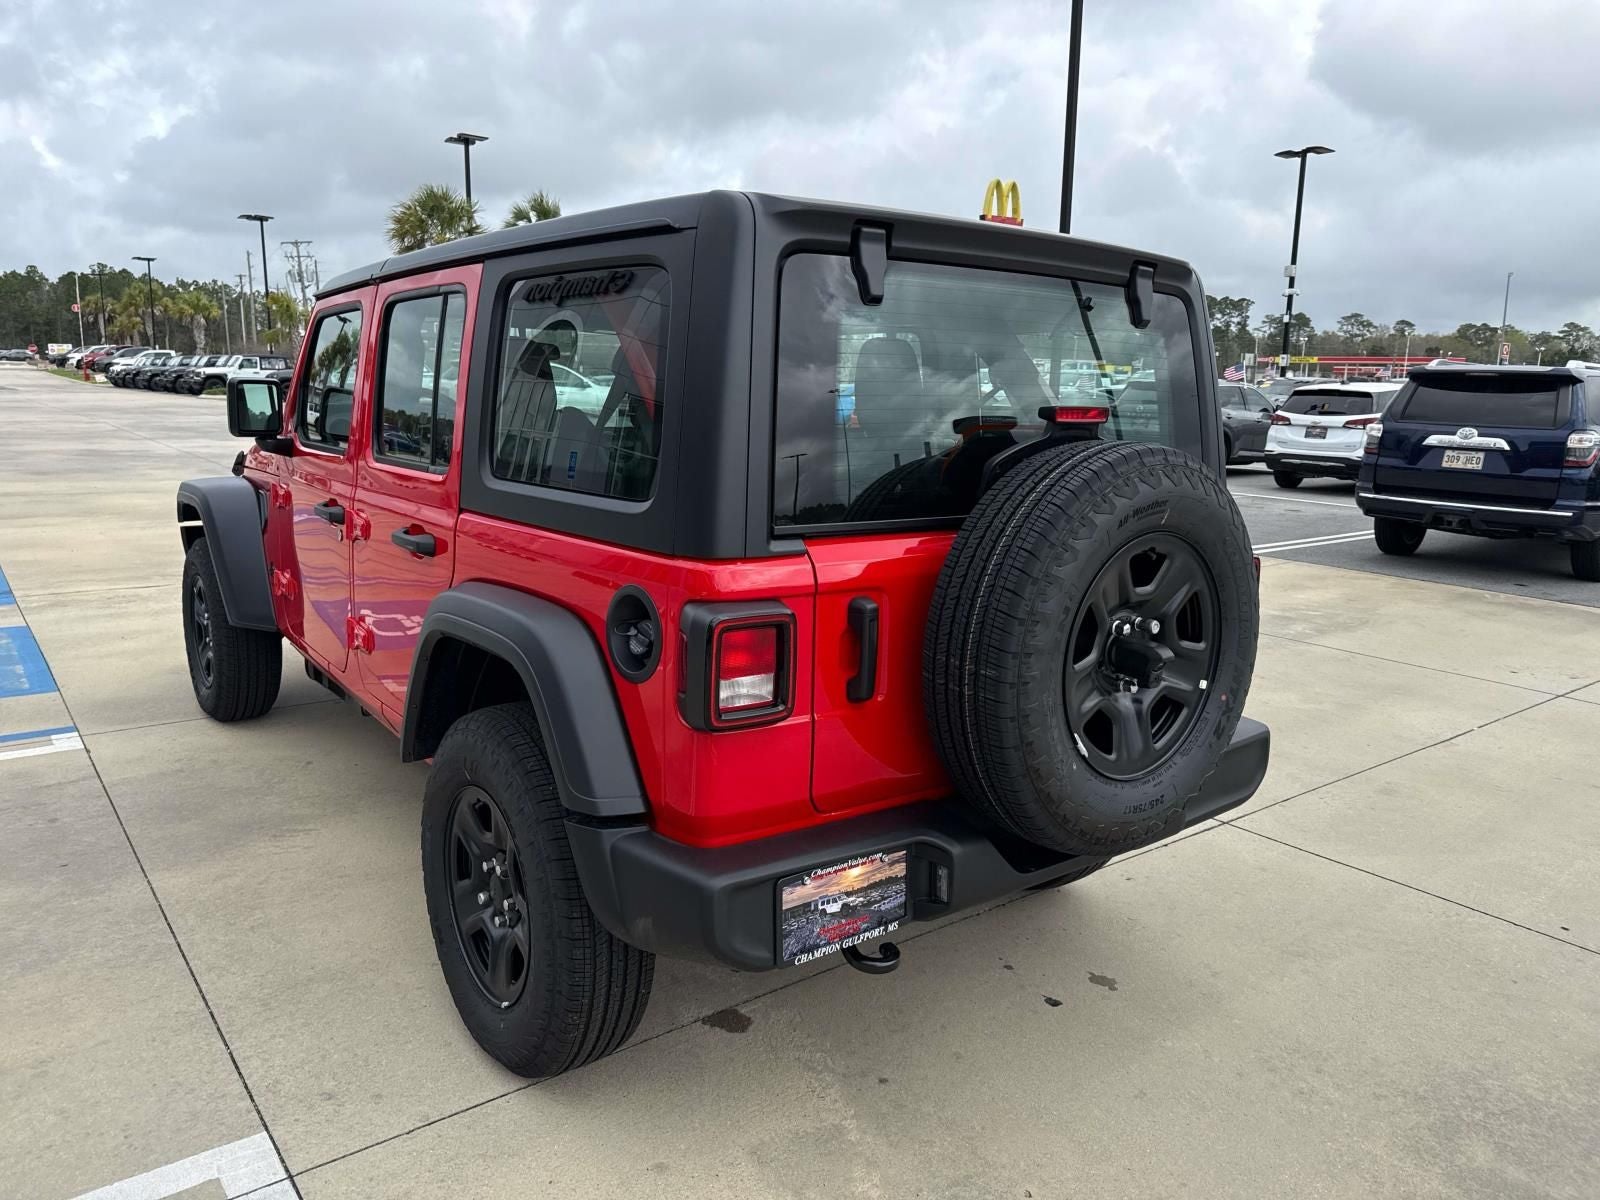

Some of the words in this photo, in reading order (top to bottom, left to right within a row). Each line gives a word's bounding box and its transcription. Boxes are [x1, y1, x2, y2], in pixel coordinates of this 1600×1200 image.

[1445, 454, 1460, 464] 309
[811, 852, 883, 878] ChampionValue.com
[794, 942, 841, 966] CHAMPION
[842, 926, 886, 949] GULFPORT,
[887, 920, 899, 933] MS
